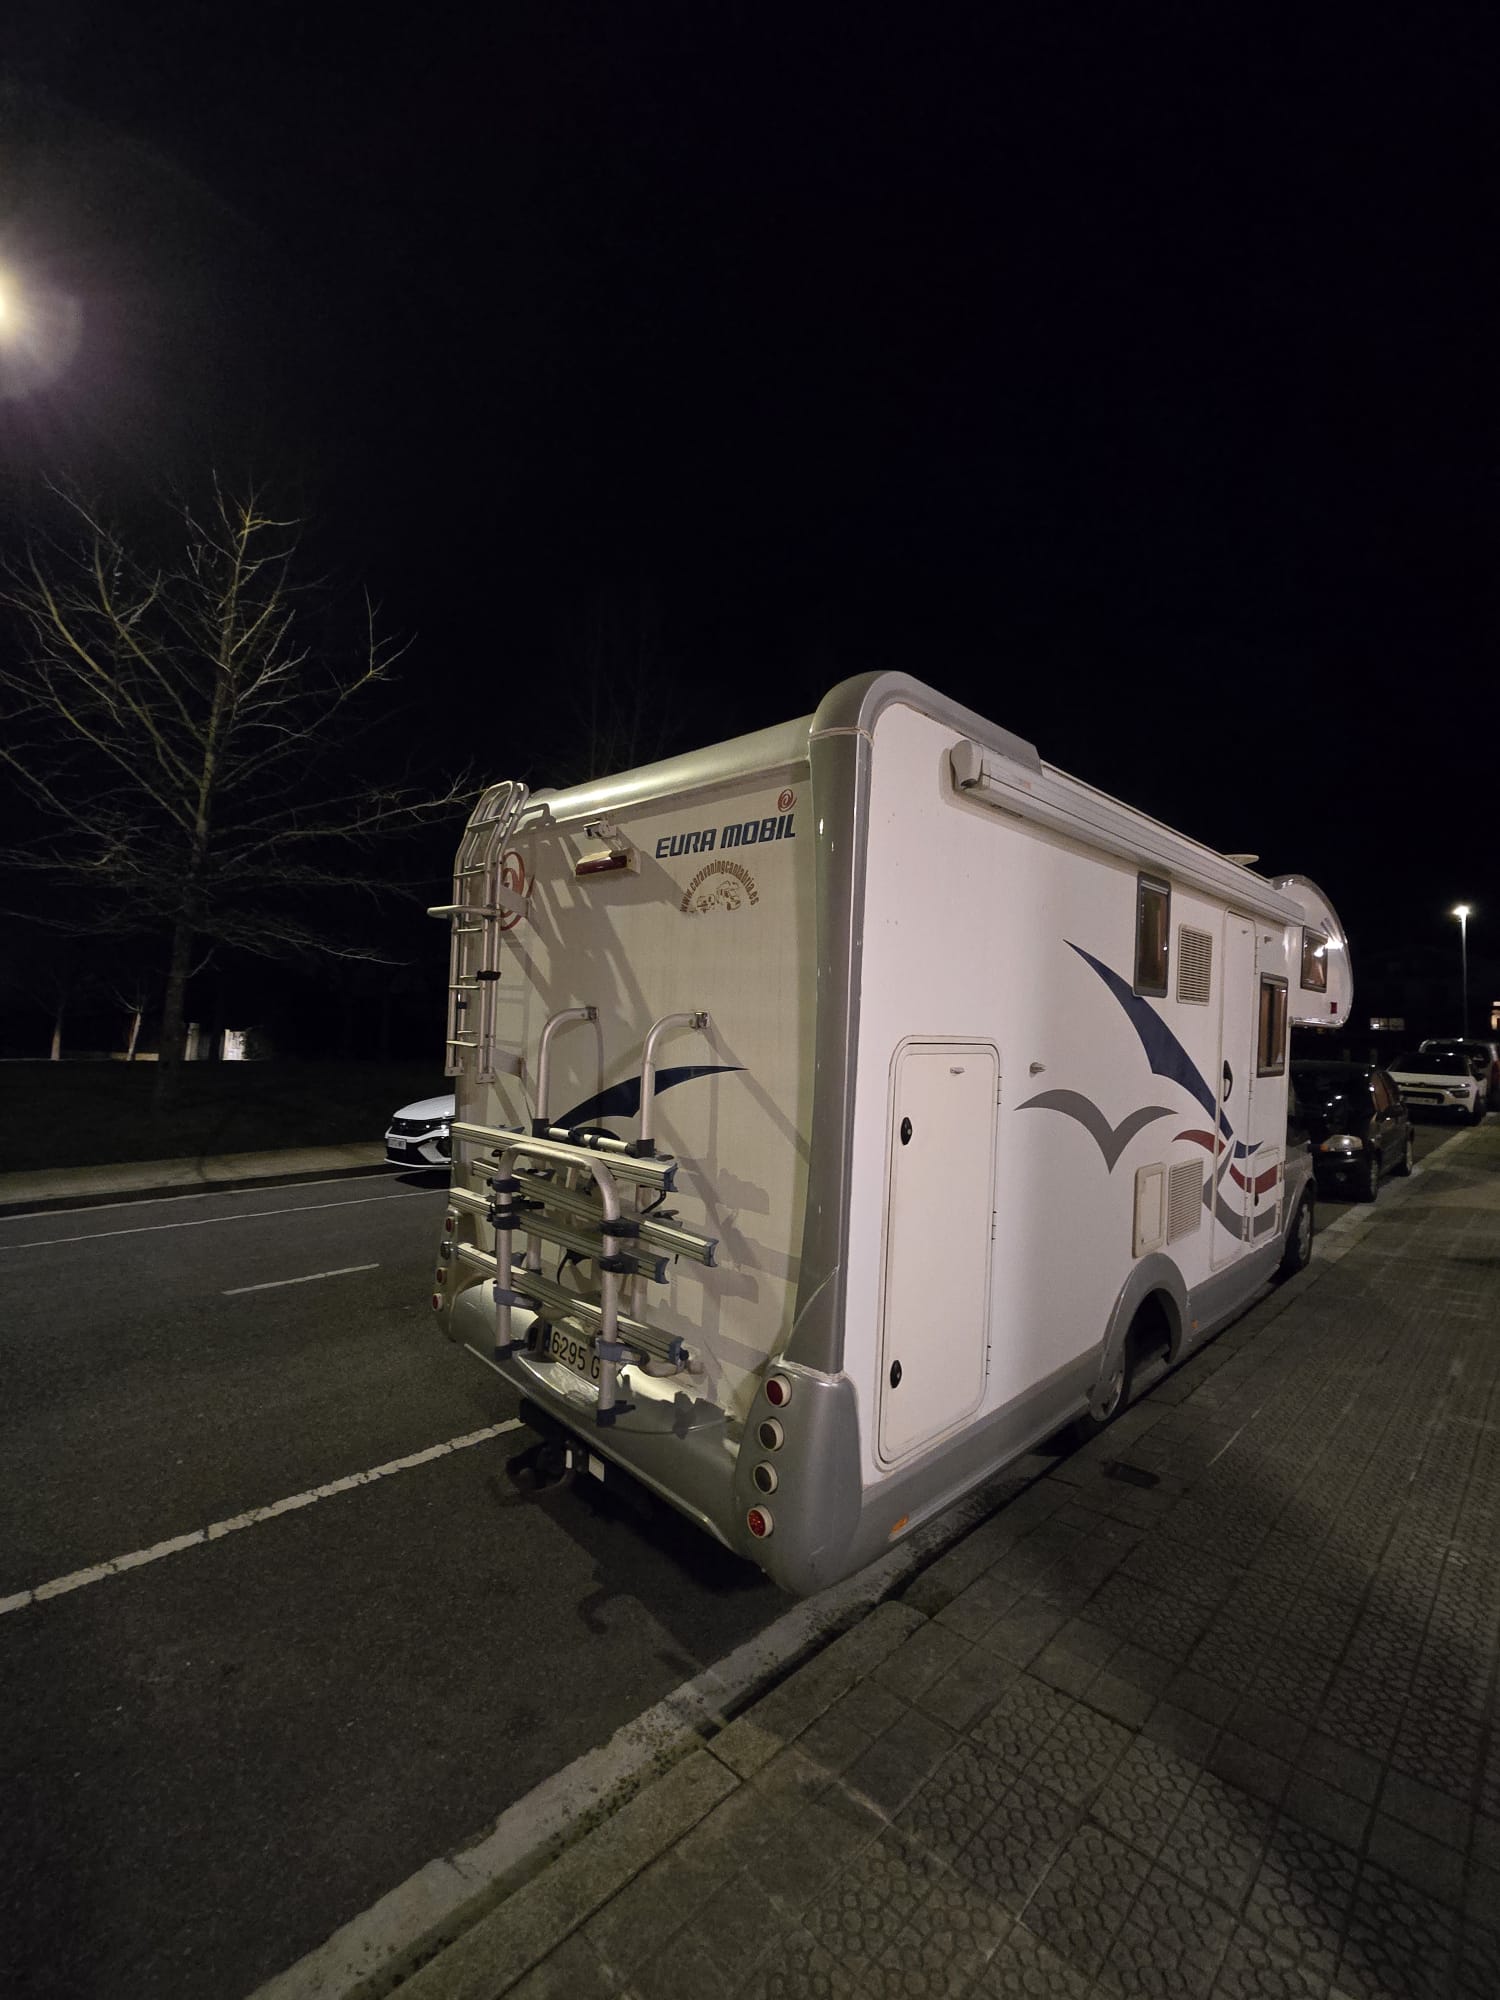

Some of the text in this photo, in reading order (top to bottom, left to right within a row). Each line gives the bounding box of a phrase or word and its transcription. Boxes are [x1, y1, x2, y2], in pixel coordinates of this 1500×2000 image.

[655, 814, 795, 859] EURA MOBIL
[680, 859, 760, 912] www.caravaningcantabria.es
[551, 1331, 586, 1371] 6295
